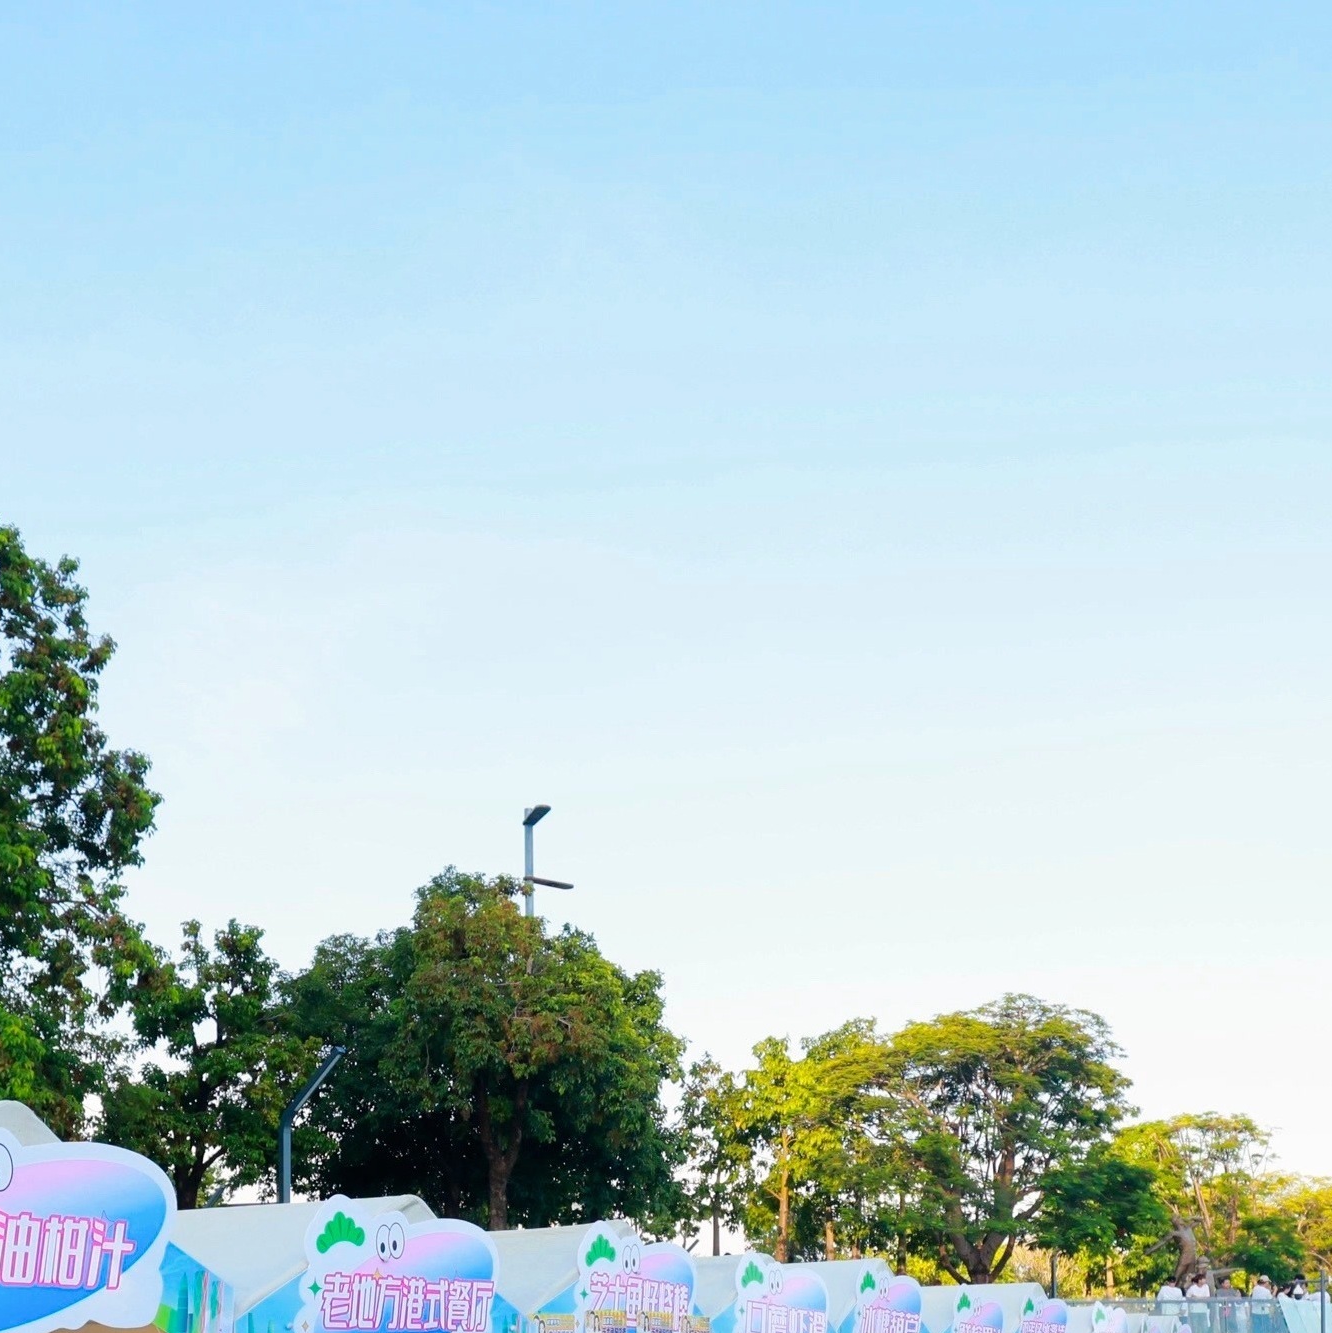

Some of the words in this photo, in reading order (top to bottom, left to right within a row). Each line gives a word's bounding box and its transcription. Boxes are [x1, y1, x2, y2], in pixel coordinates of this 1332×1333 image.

[321, 1272, 494, 1332] 老地方港式餐厅
